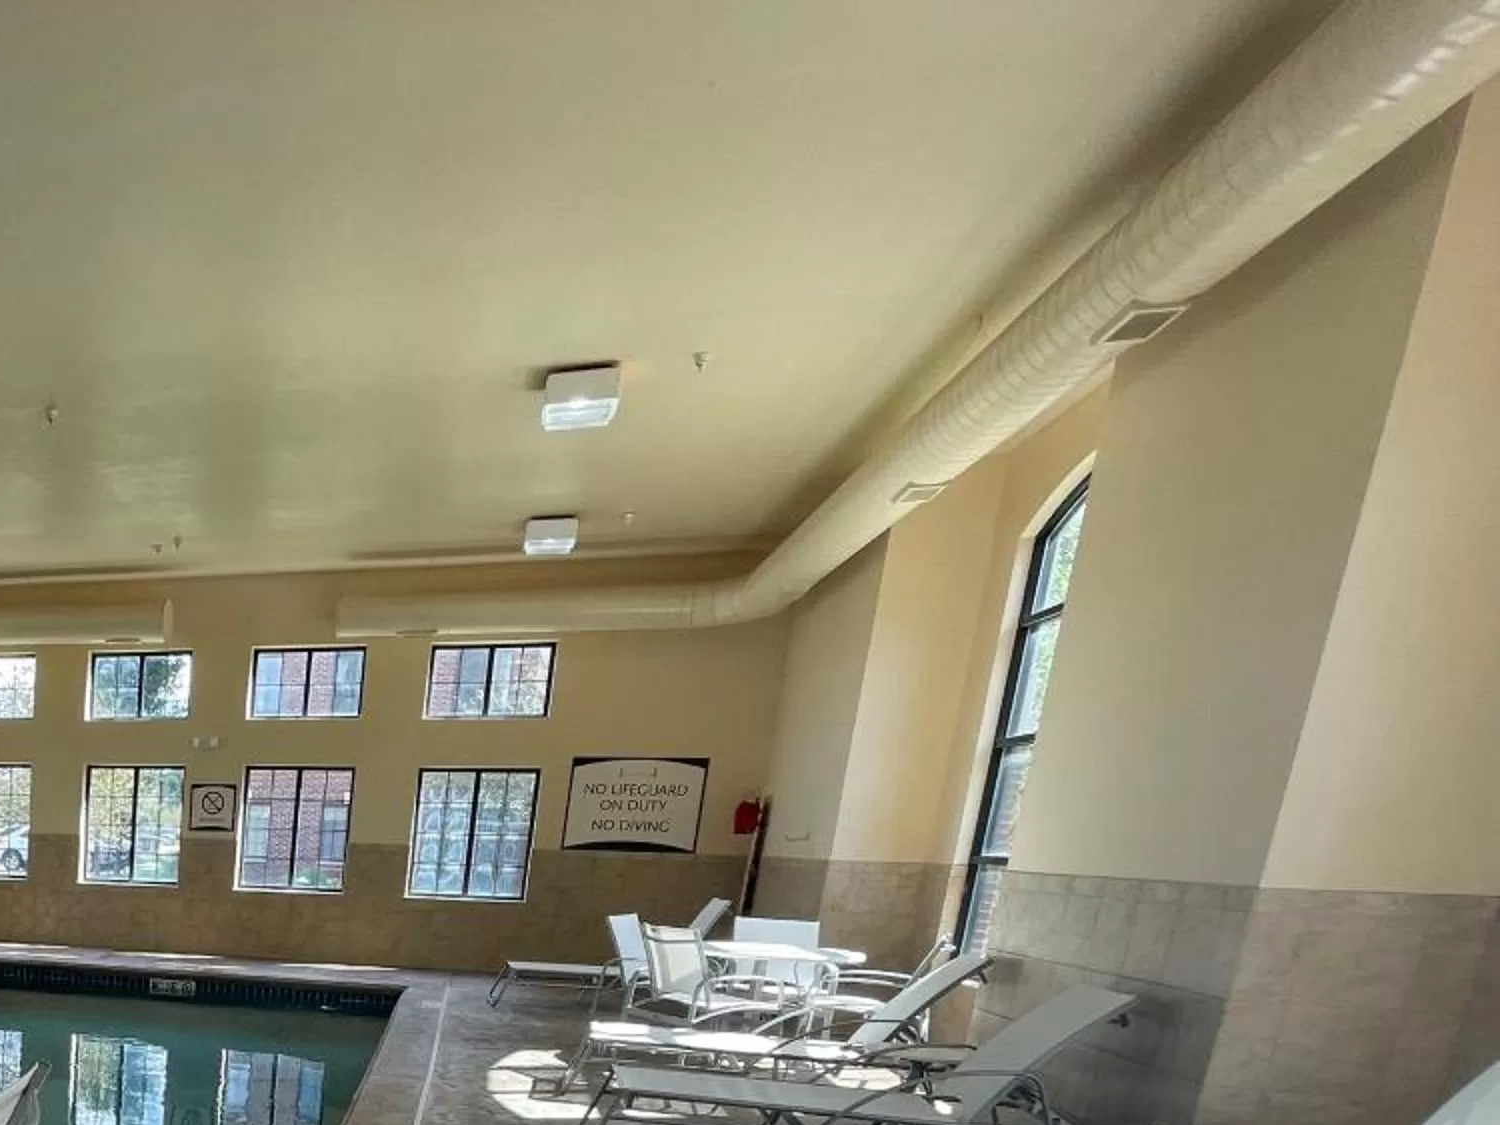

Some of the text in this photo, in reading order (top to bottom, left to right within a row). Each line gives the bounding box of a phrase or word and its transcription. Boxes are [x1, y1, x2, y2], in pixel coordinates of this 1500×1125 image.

[583, 783, 689, 797] NO LIFEGUARD
[599, 799, 668, 812] ON DUTY
[591, 819, 670, 833] NO DIVING
